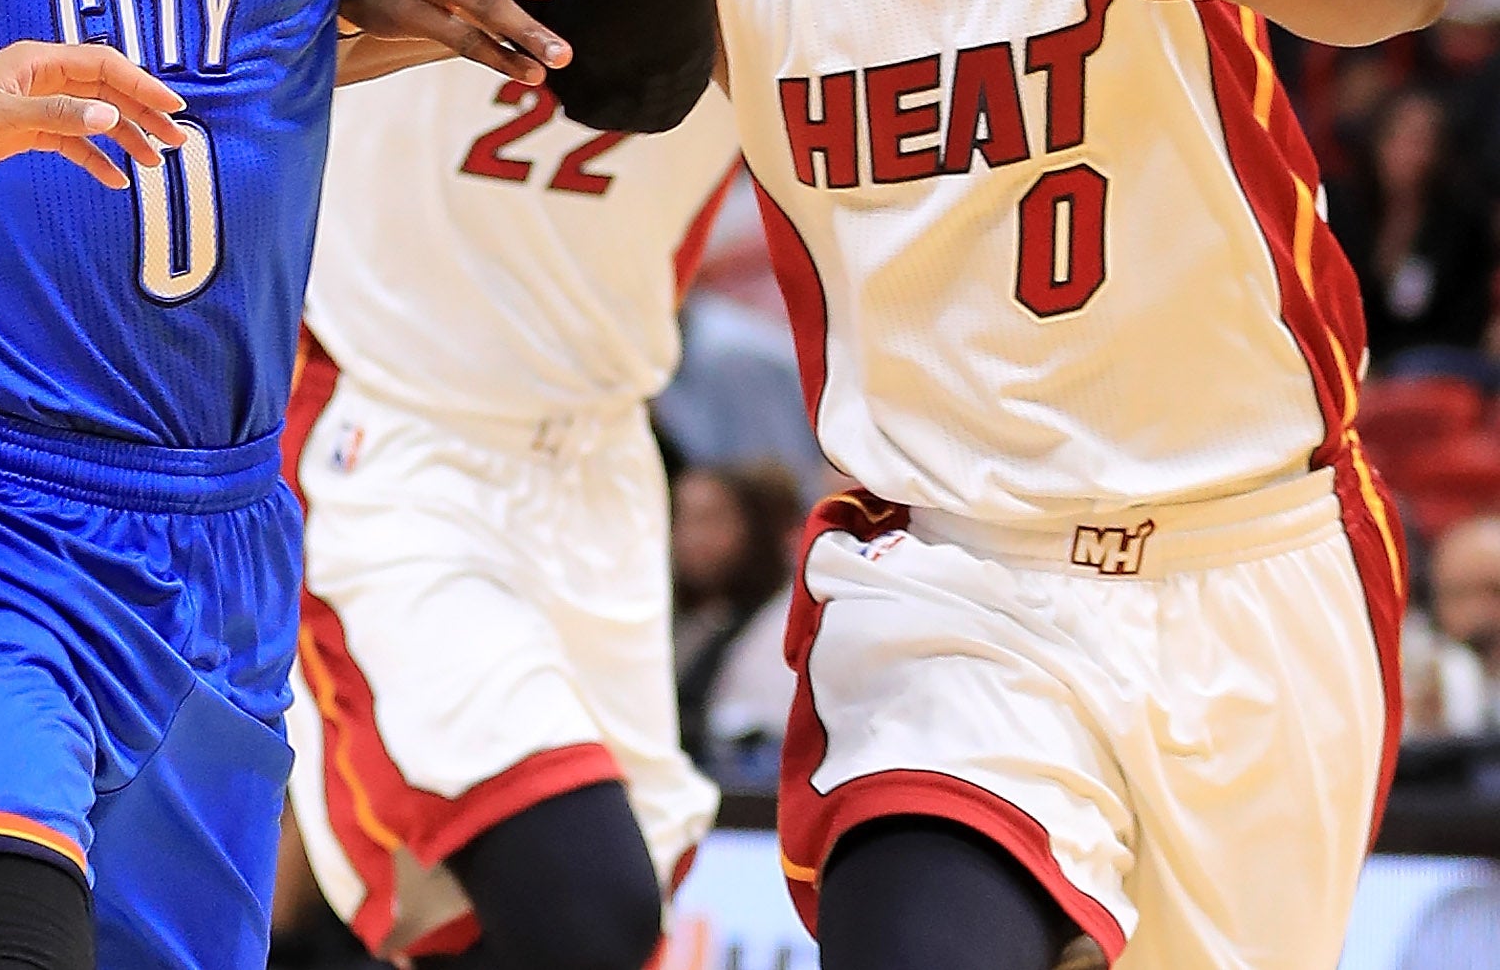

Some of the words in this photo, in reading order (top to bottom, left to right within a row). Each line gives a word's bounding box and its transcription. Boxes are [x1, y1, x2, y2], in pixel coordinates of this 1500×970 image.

[128, 112, 225, 308] 0
[458, 80, 636, 198] 22
[1013, 161, 1111, 320] 0
